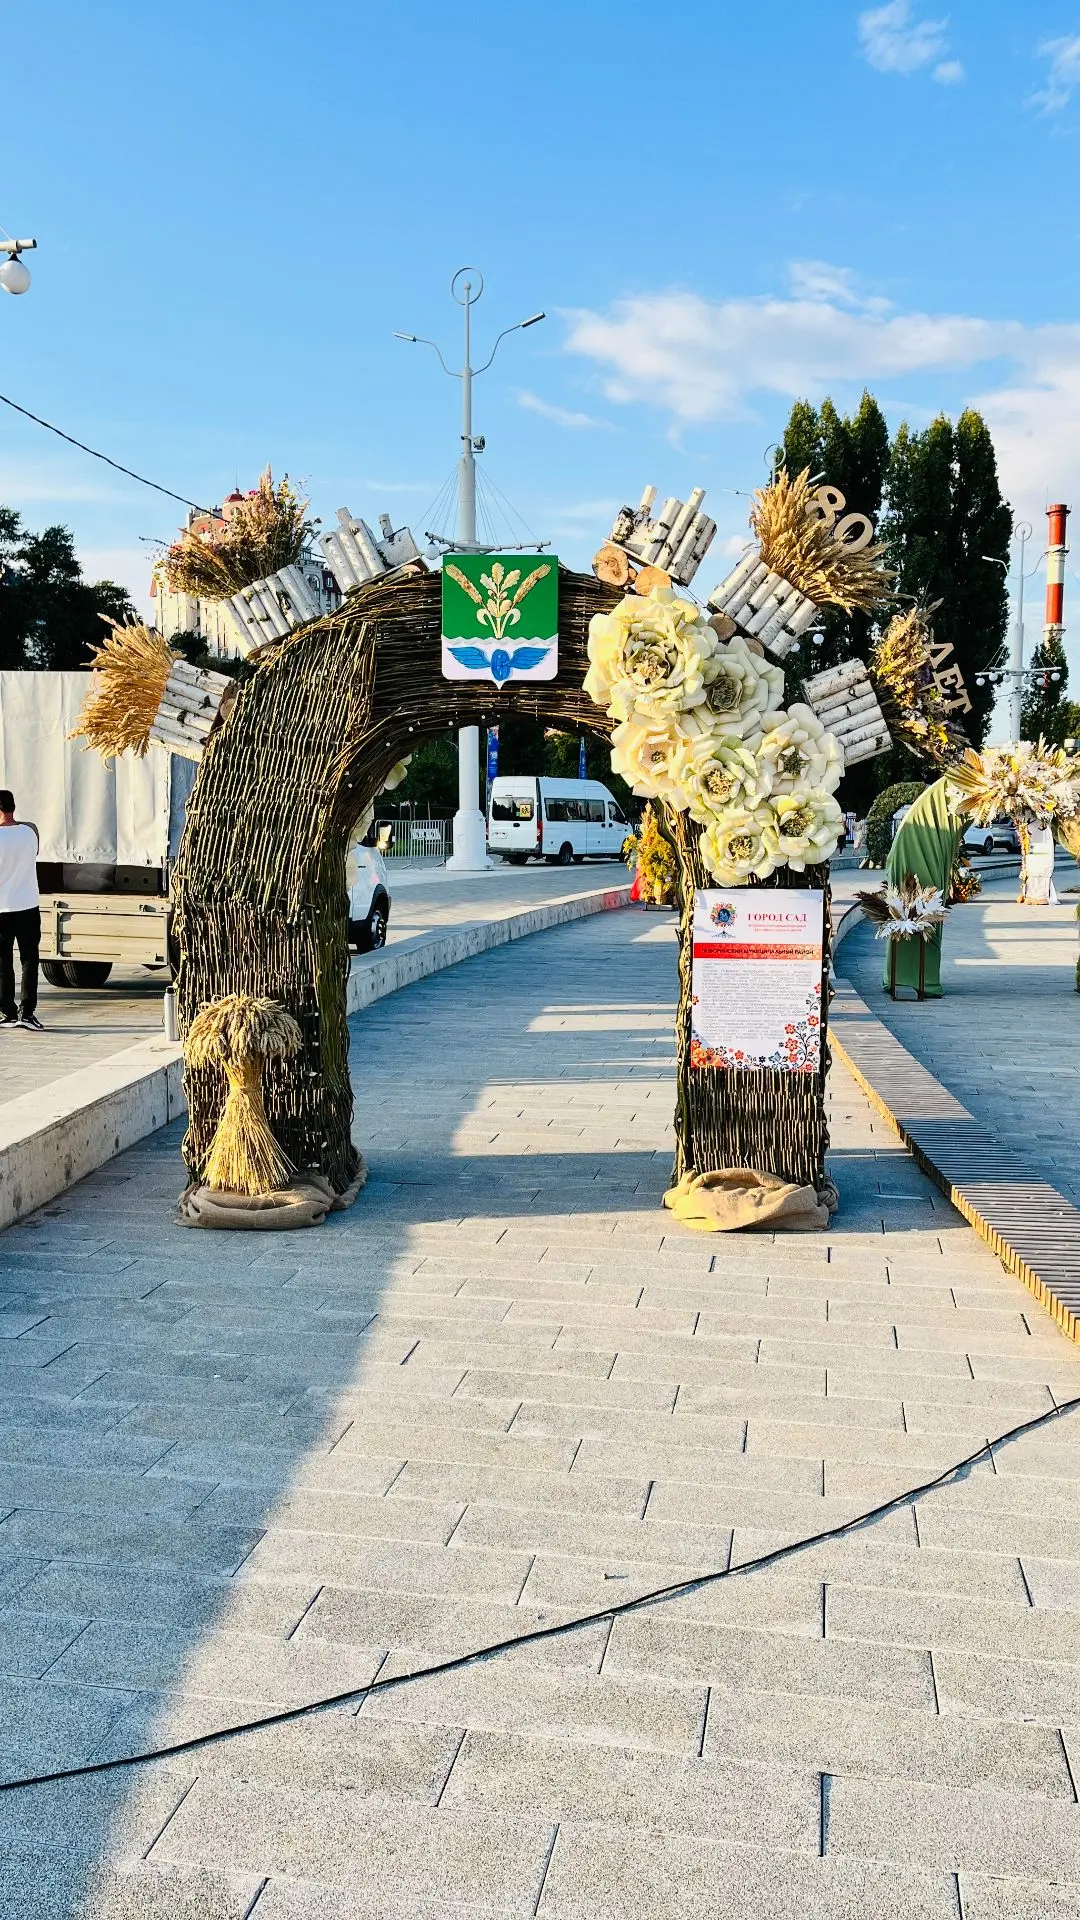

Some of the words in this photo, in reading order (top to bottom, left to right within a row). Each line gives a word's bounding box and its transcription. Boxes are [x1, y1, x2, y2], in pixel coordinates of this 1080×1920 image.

[805, 485, 874, 553] 80
[921, 642, 973, 715] ЛЕТ
[747, 913, 783, 922] ГОРОД
[785, 913, 808, 922] САД
